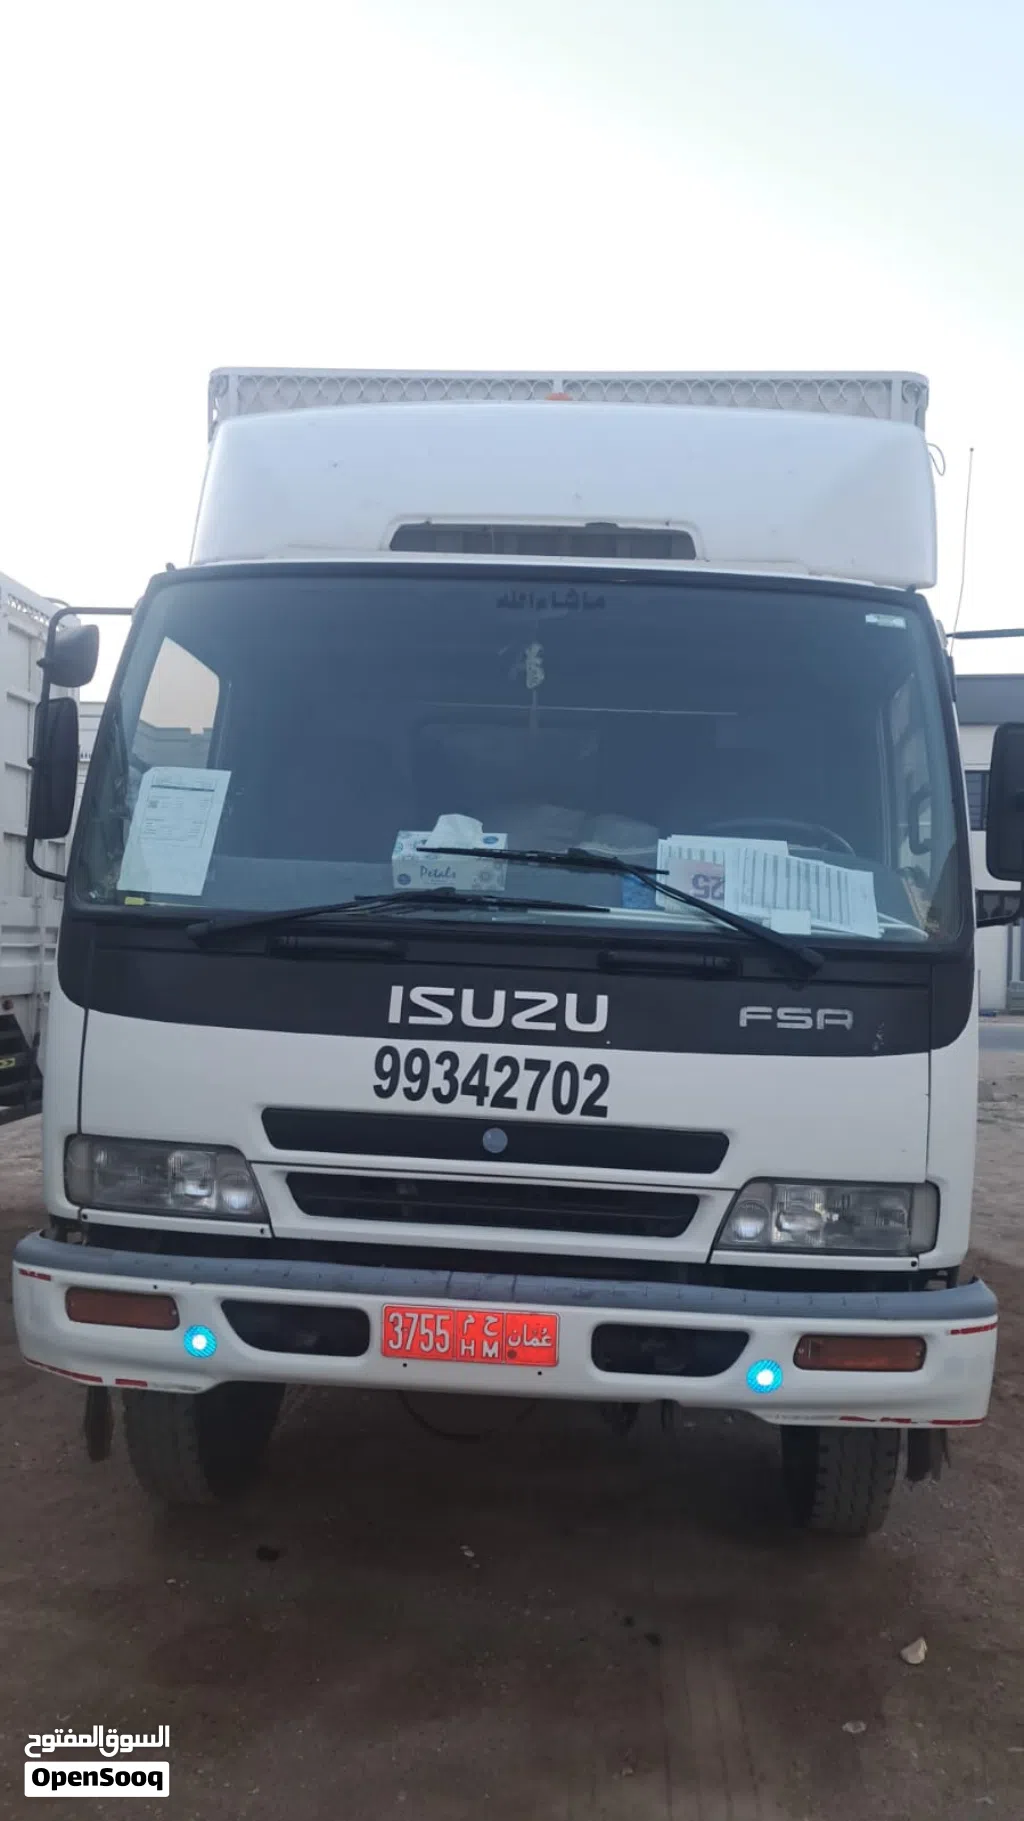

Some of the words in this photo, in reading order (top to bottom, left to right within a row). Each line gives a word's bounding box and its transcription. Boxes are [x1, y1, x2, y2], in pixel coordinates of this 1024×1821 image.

[388, 985, 609, 1032] ISUZU
[373, 1045, 610, 1118] 99342702
[388, 1312, 450, 1353] 3755
